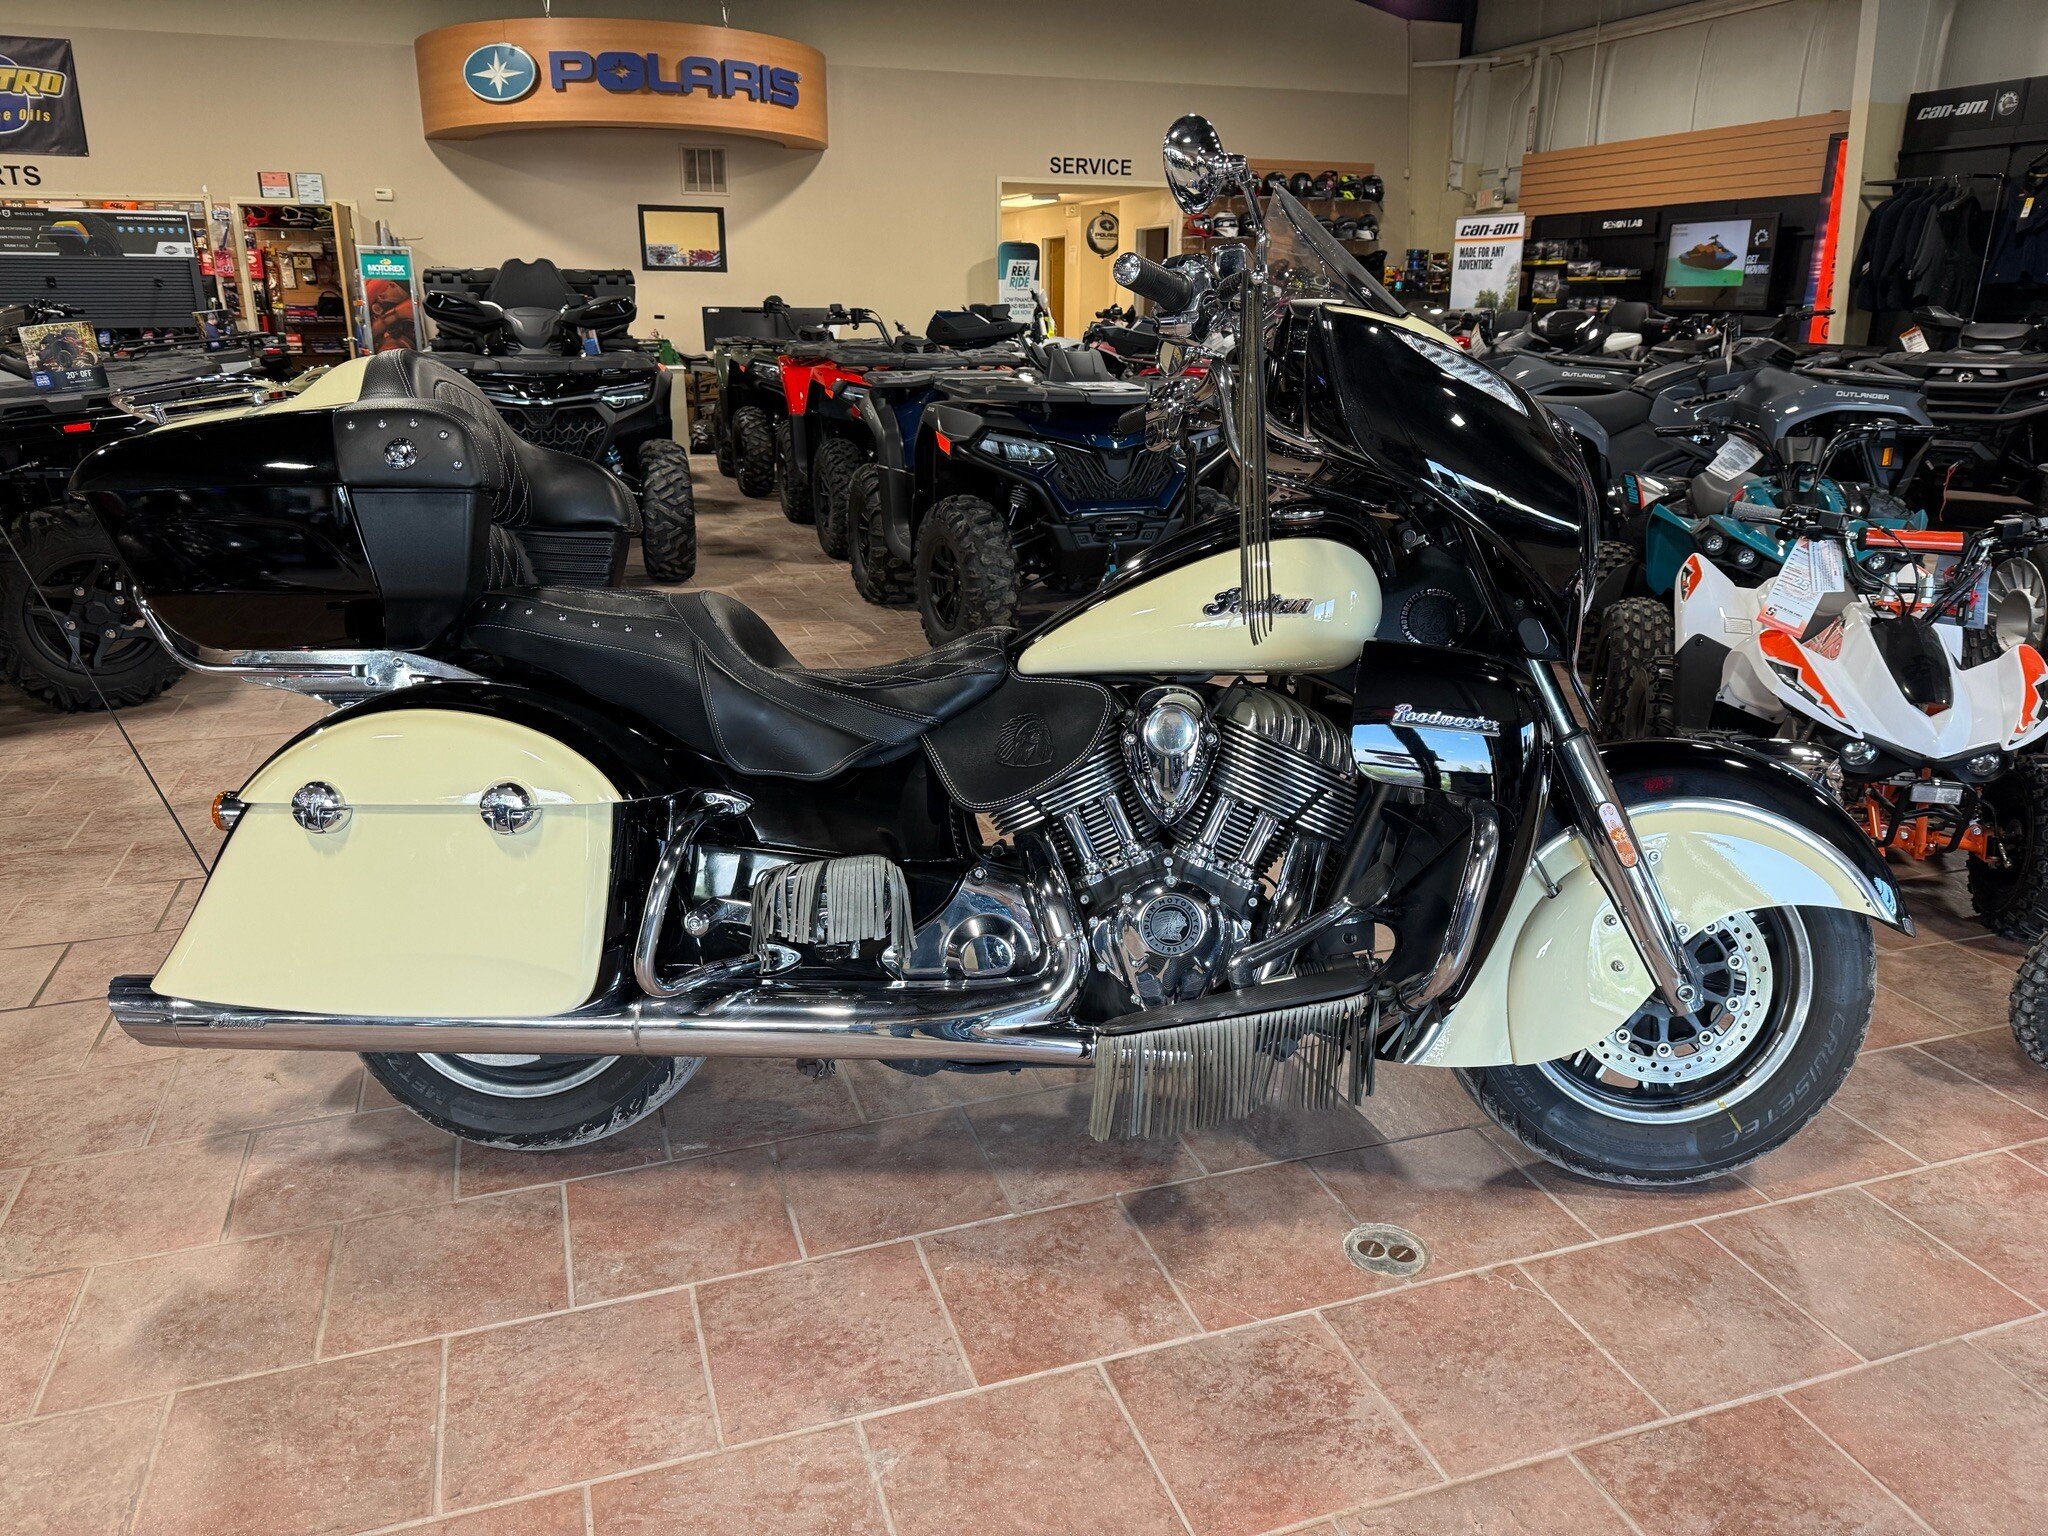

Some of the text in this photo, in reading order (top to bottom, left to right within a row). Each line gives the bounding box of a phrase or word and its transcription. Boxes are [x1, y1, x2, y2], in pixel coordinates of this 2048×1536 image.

[548, 51, 801, 108] POLARIS
[19, 109, 51, 122] Oils
[1917, 100, 1988, 120] can-am
[1050, 157, 1132, 176] SERVICE
[1461, 223, 1519, 236] can-am
[1627, 219, 1643, 228] LAB
[1459, 246, 1505, 258] MADE FOR ANY
[367, 264, 405, 272] MOTOREX
[1011, 265, 1029, 276] REV
[1458, 259, 1493, 270] ADVENTURE
[1010, 277, 1030, 288] RIDE
[1562, 371, 1606, 379] OUTLANDER
[1835, 390, 1890, 400] OUTLANDER
[1393, 703, 1500, 732] Roadmaster
[1143, 897, 1199, 943] INDIAN MOTORCYCLE
[1161, 945, 1183, 953] 1901
[1721, 1011, 1847, 1150] CRUISETEC
